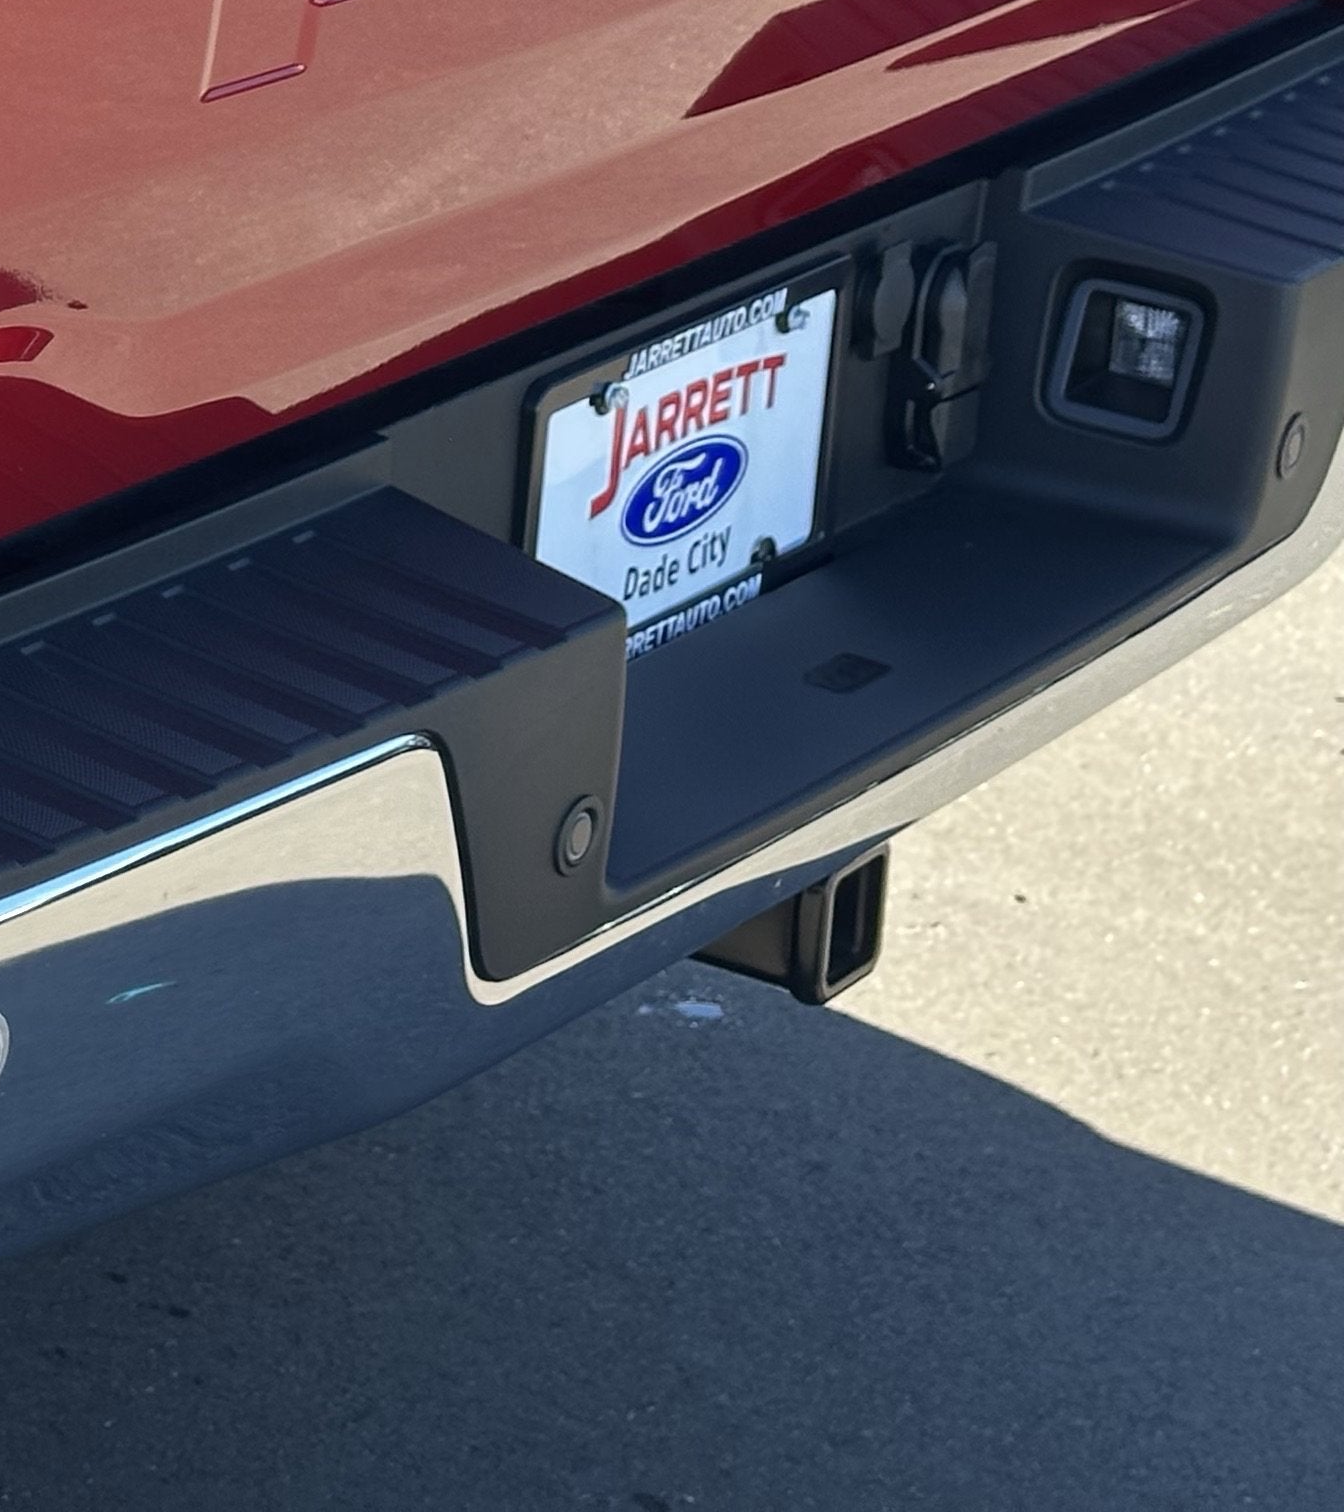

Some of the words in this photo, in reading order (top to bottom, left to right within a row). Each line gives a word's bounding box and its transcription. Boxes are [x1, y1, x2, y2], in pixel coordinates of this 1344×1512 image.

[623, 287, 789, 380] JARRETTAUTO.COM
[588, 353, 787, 521] JARRETT
[641, 451, 724, 534] Ford
[622, 552, 680, 601] Dade
[686, 524, 732, 575] City
